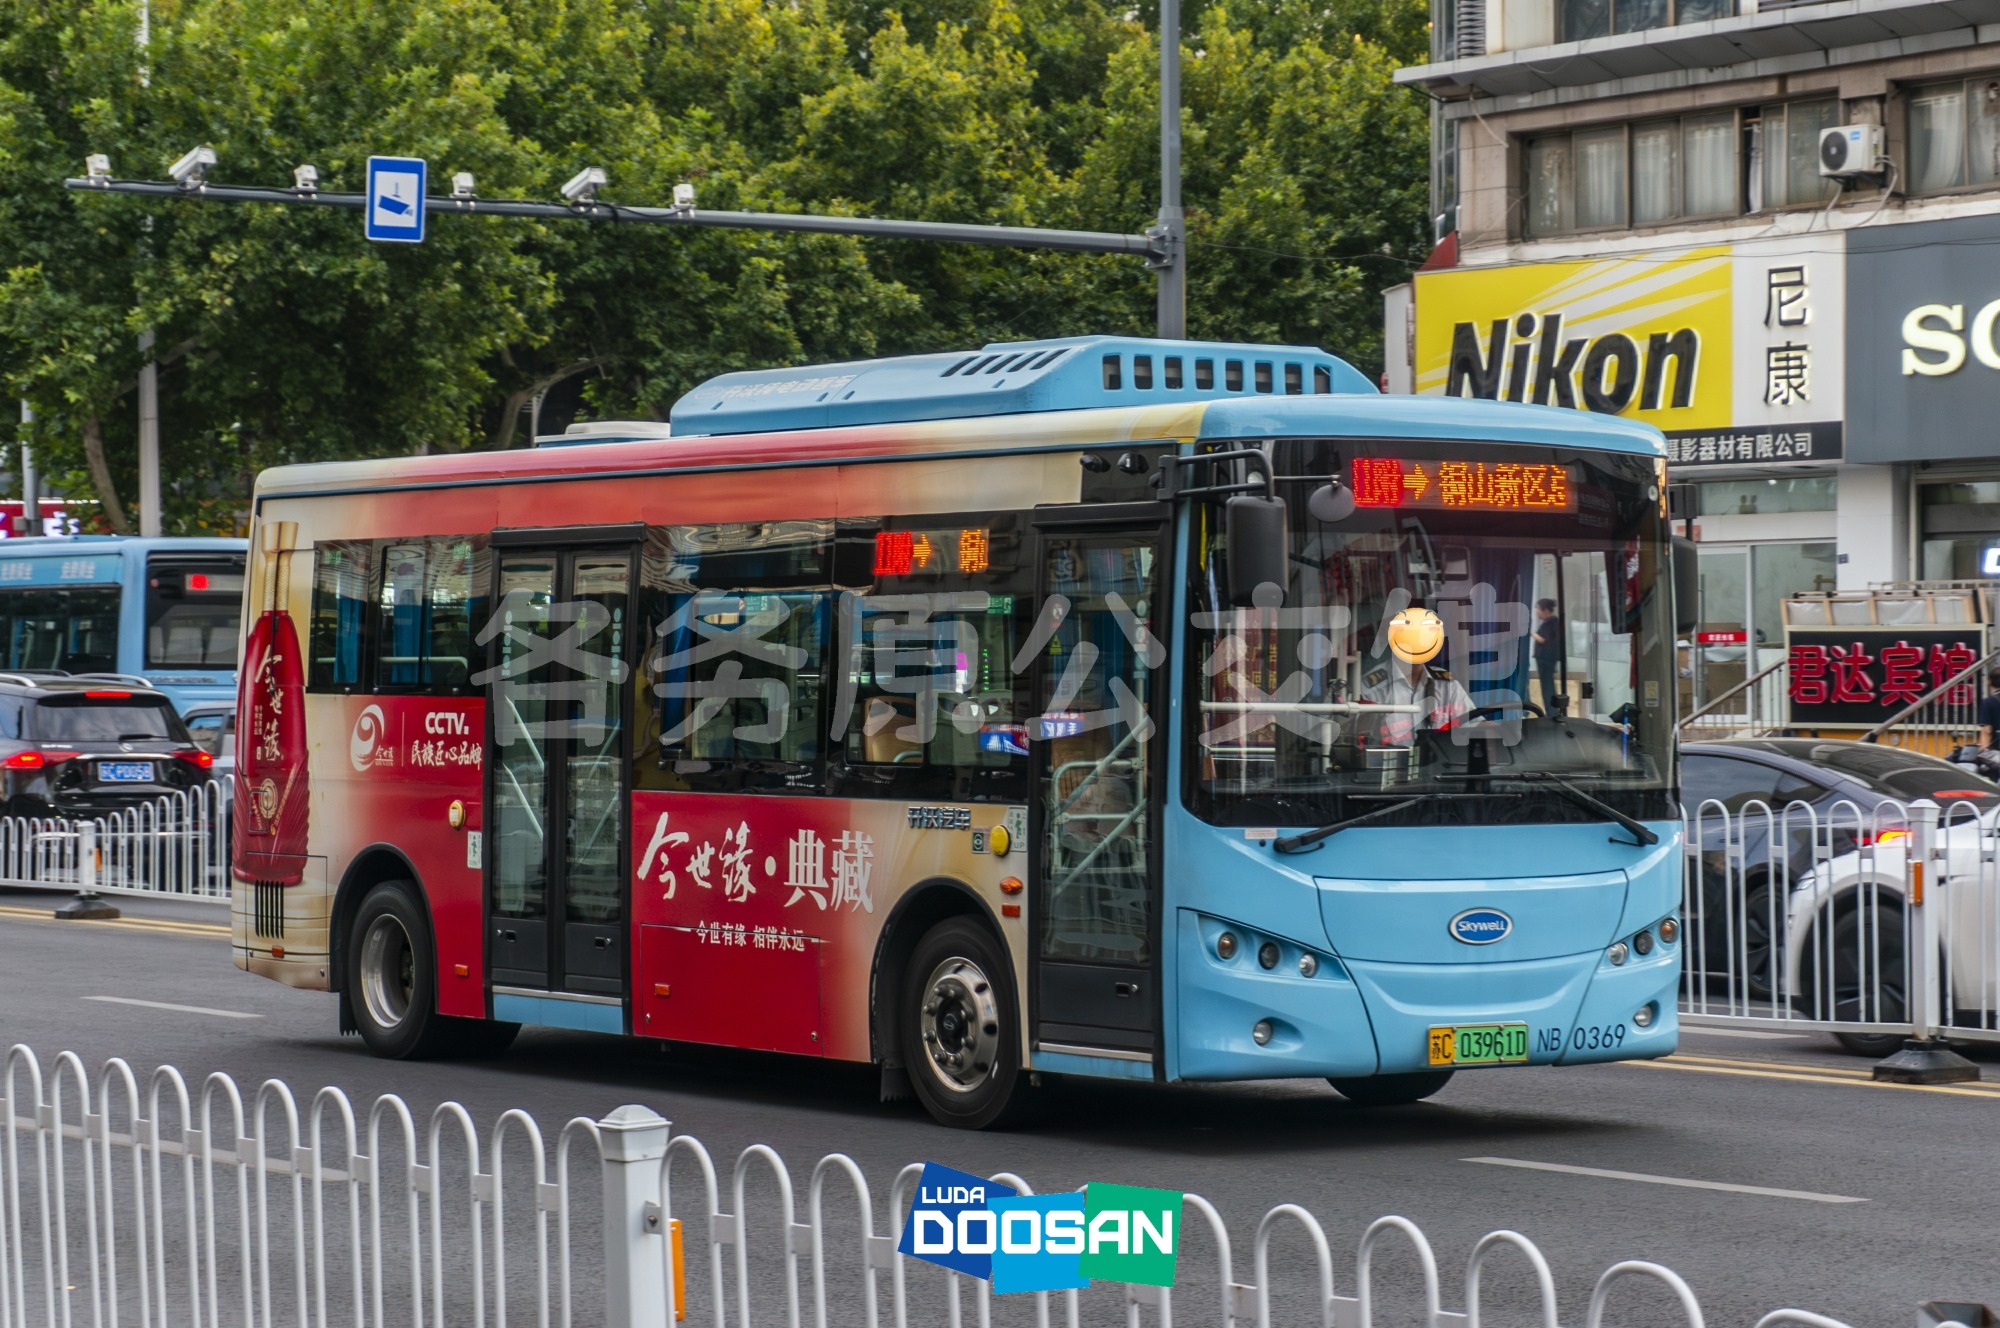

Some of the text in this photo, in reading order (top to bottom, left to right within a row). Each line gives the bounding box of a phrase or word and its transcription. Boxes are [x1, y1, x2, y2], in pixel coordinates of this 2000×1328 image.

[1763, 265, 1813, 406] 尼康
[1446, 312, 1701, 415] Nikon
[1788, 641, 1977, 706] 君达宾馆
[411, 739, 482, 770] 民族匠心品牌
[696, 920, 806, 951] 今世有缘 相伴永远
[1457, 920, 1506, 933] Skywell
[1461, 1030, 1526, 1058] 03961D
[1537, 1023, 1626, 1053] NB 0369
